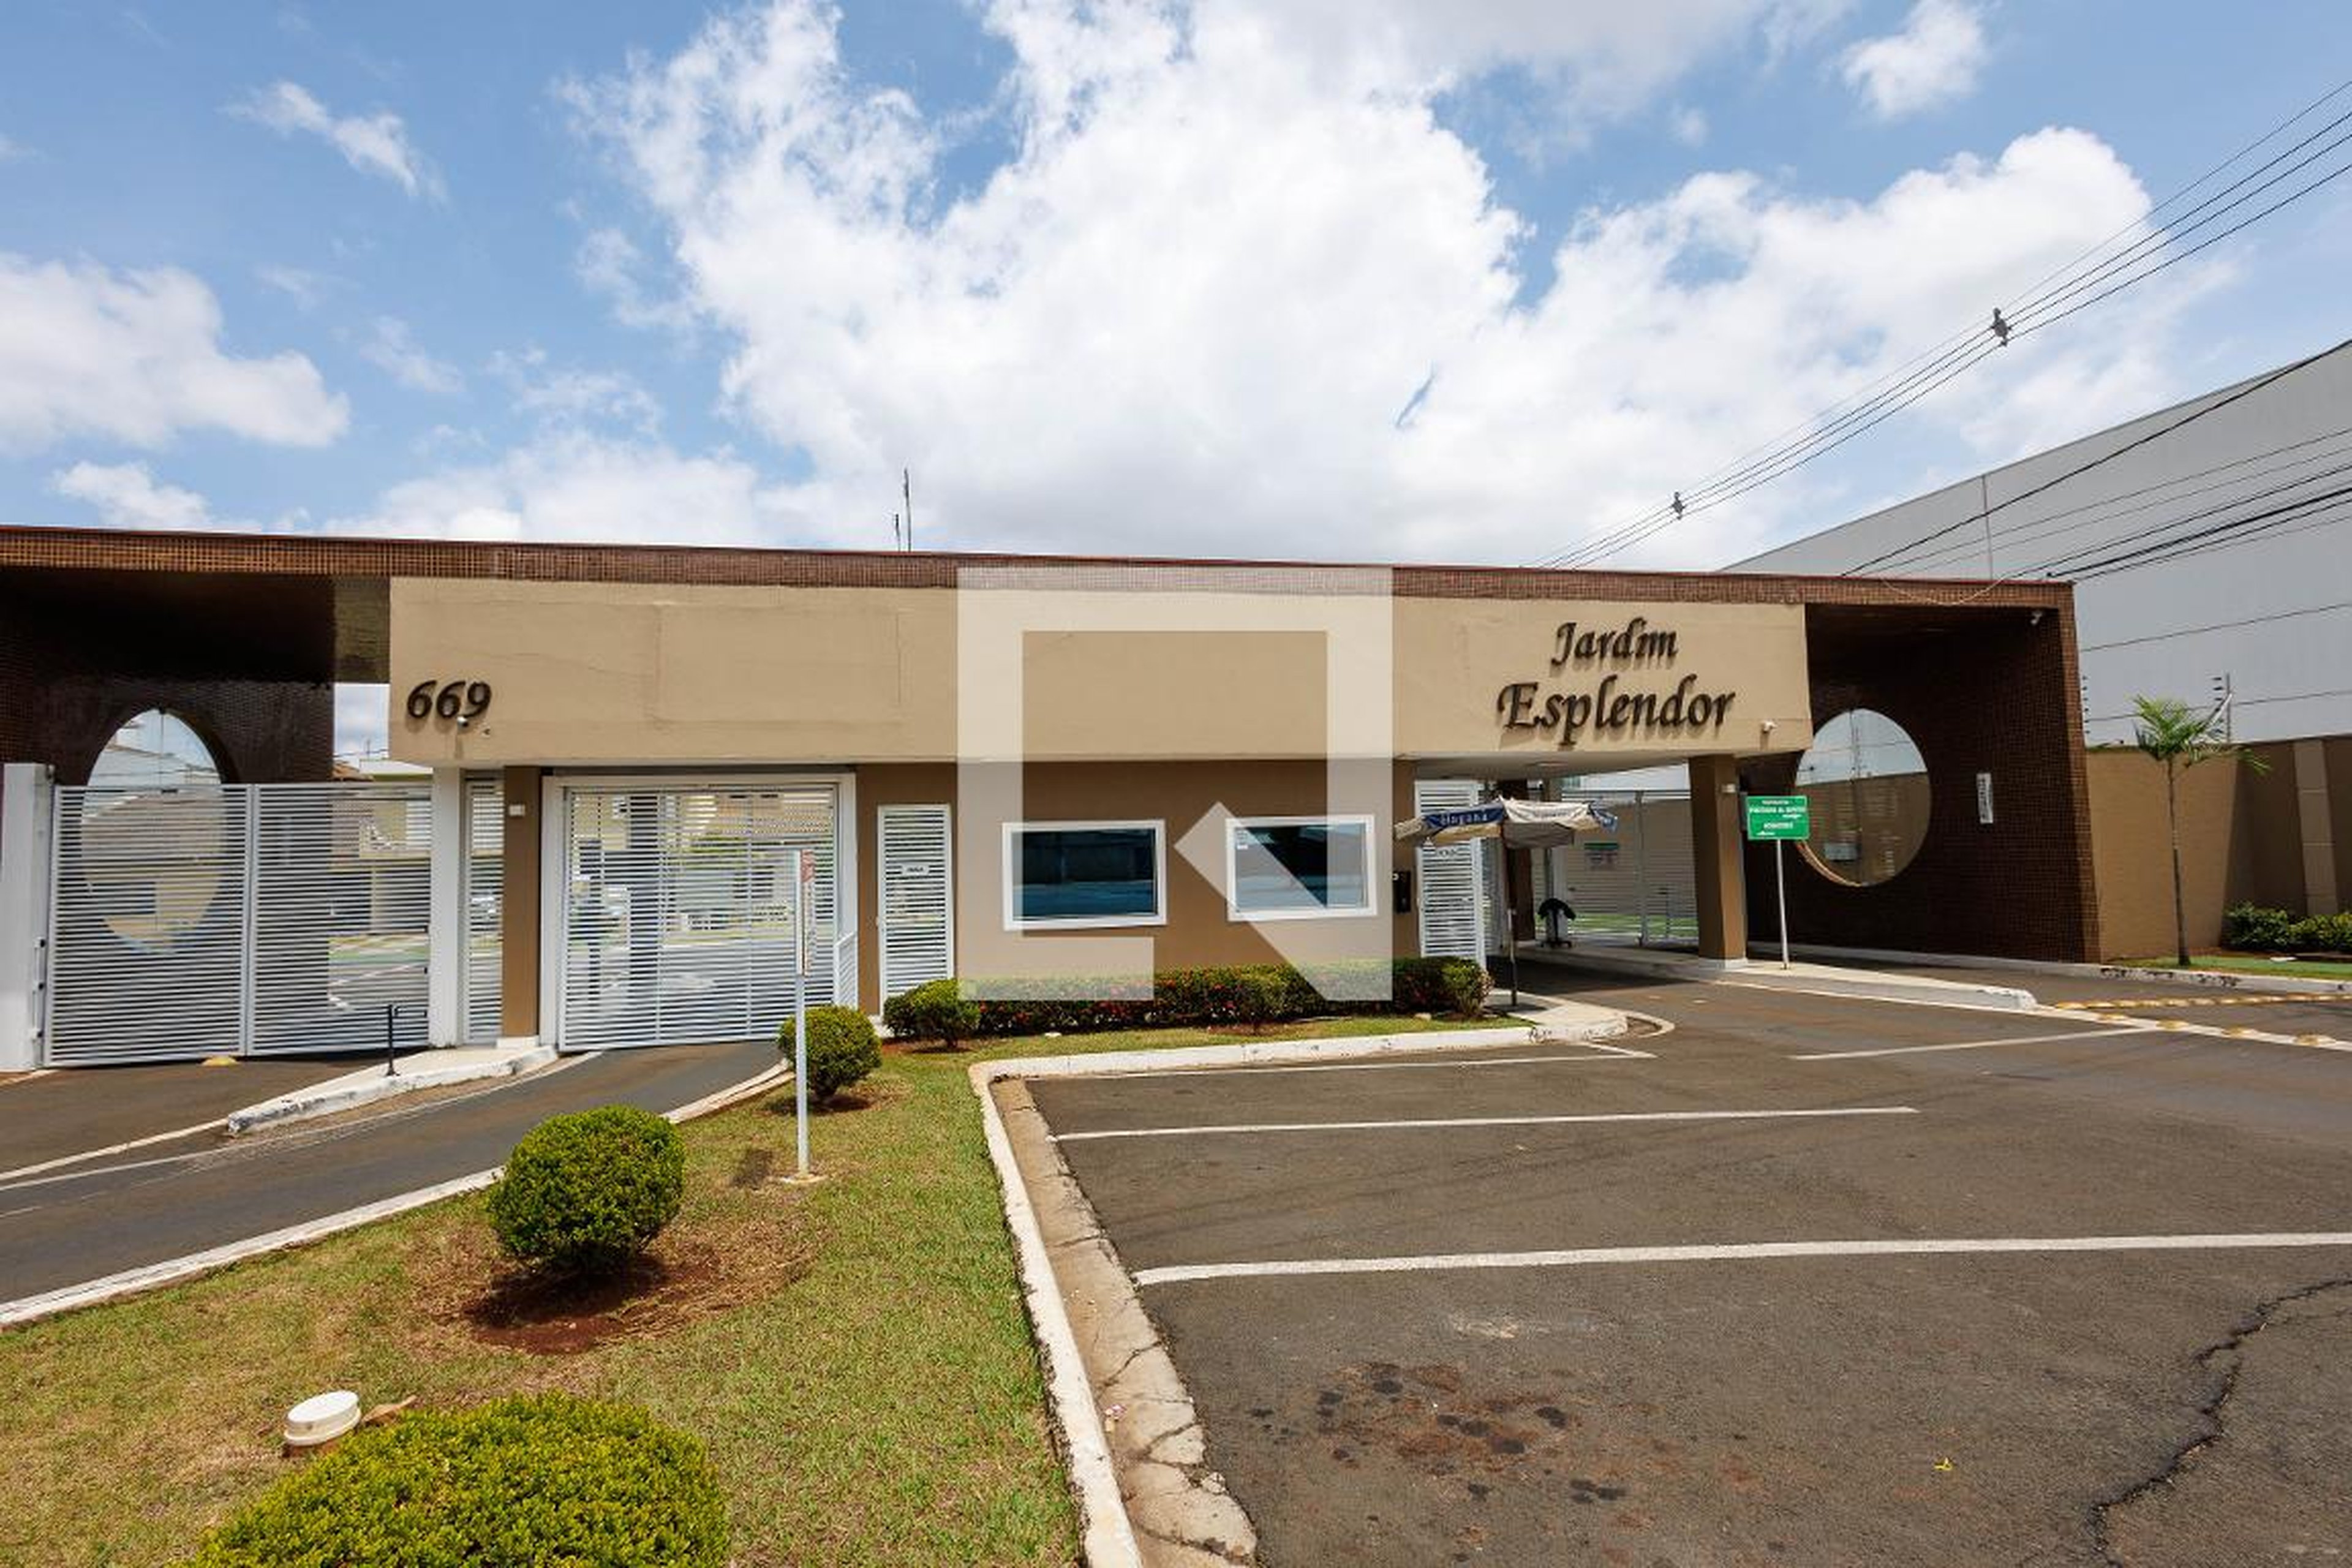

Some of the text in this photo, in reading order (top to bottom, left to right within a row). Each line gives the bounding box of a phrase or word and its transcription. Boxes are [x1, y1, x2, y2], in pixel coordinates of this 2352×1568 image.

[1551, 617, 1678, 666] Jardim
[407, 680, 492, 719] 669
[1496, 674, 1736, 745] Esplendor
